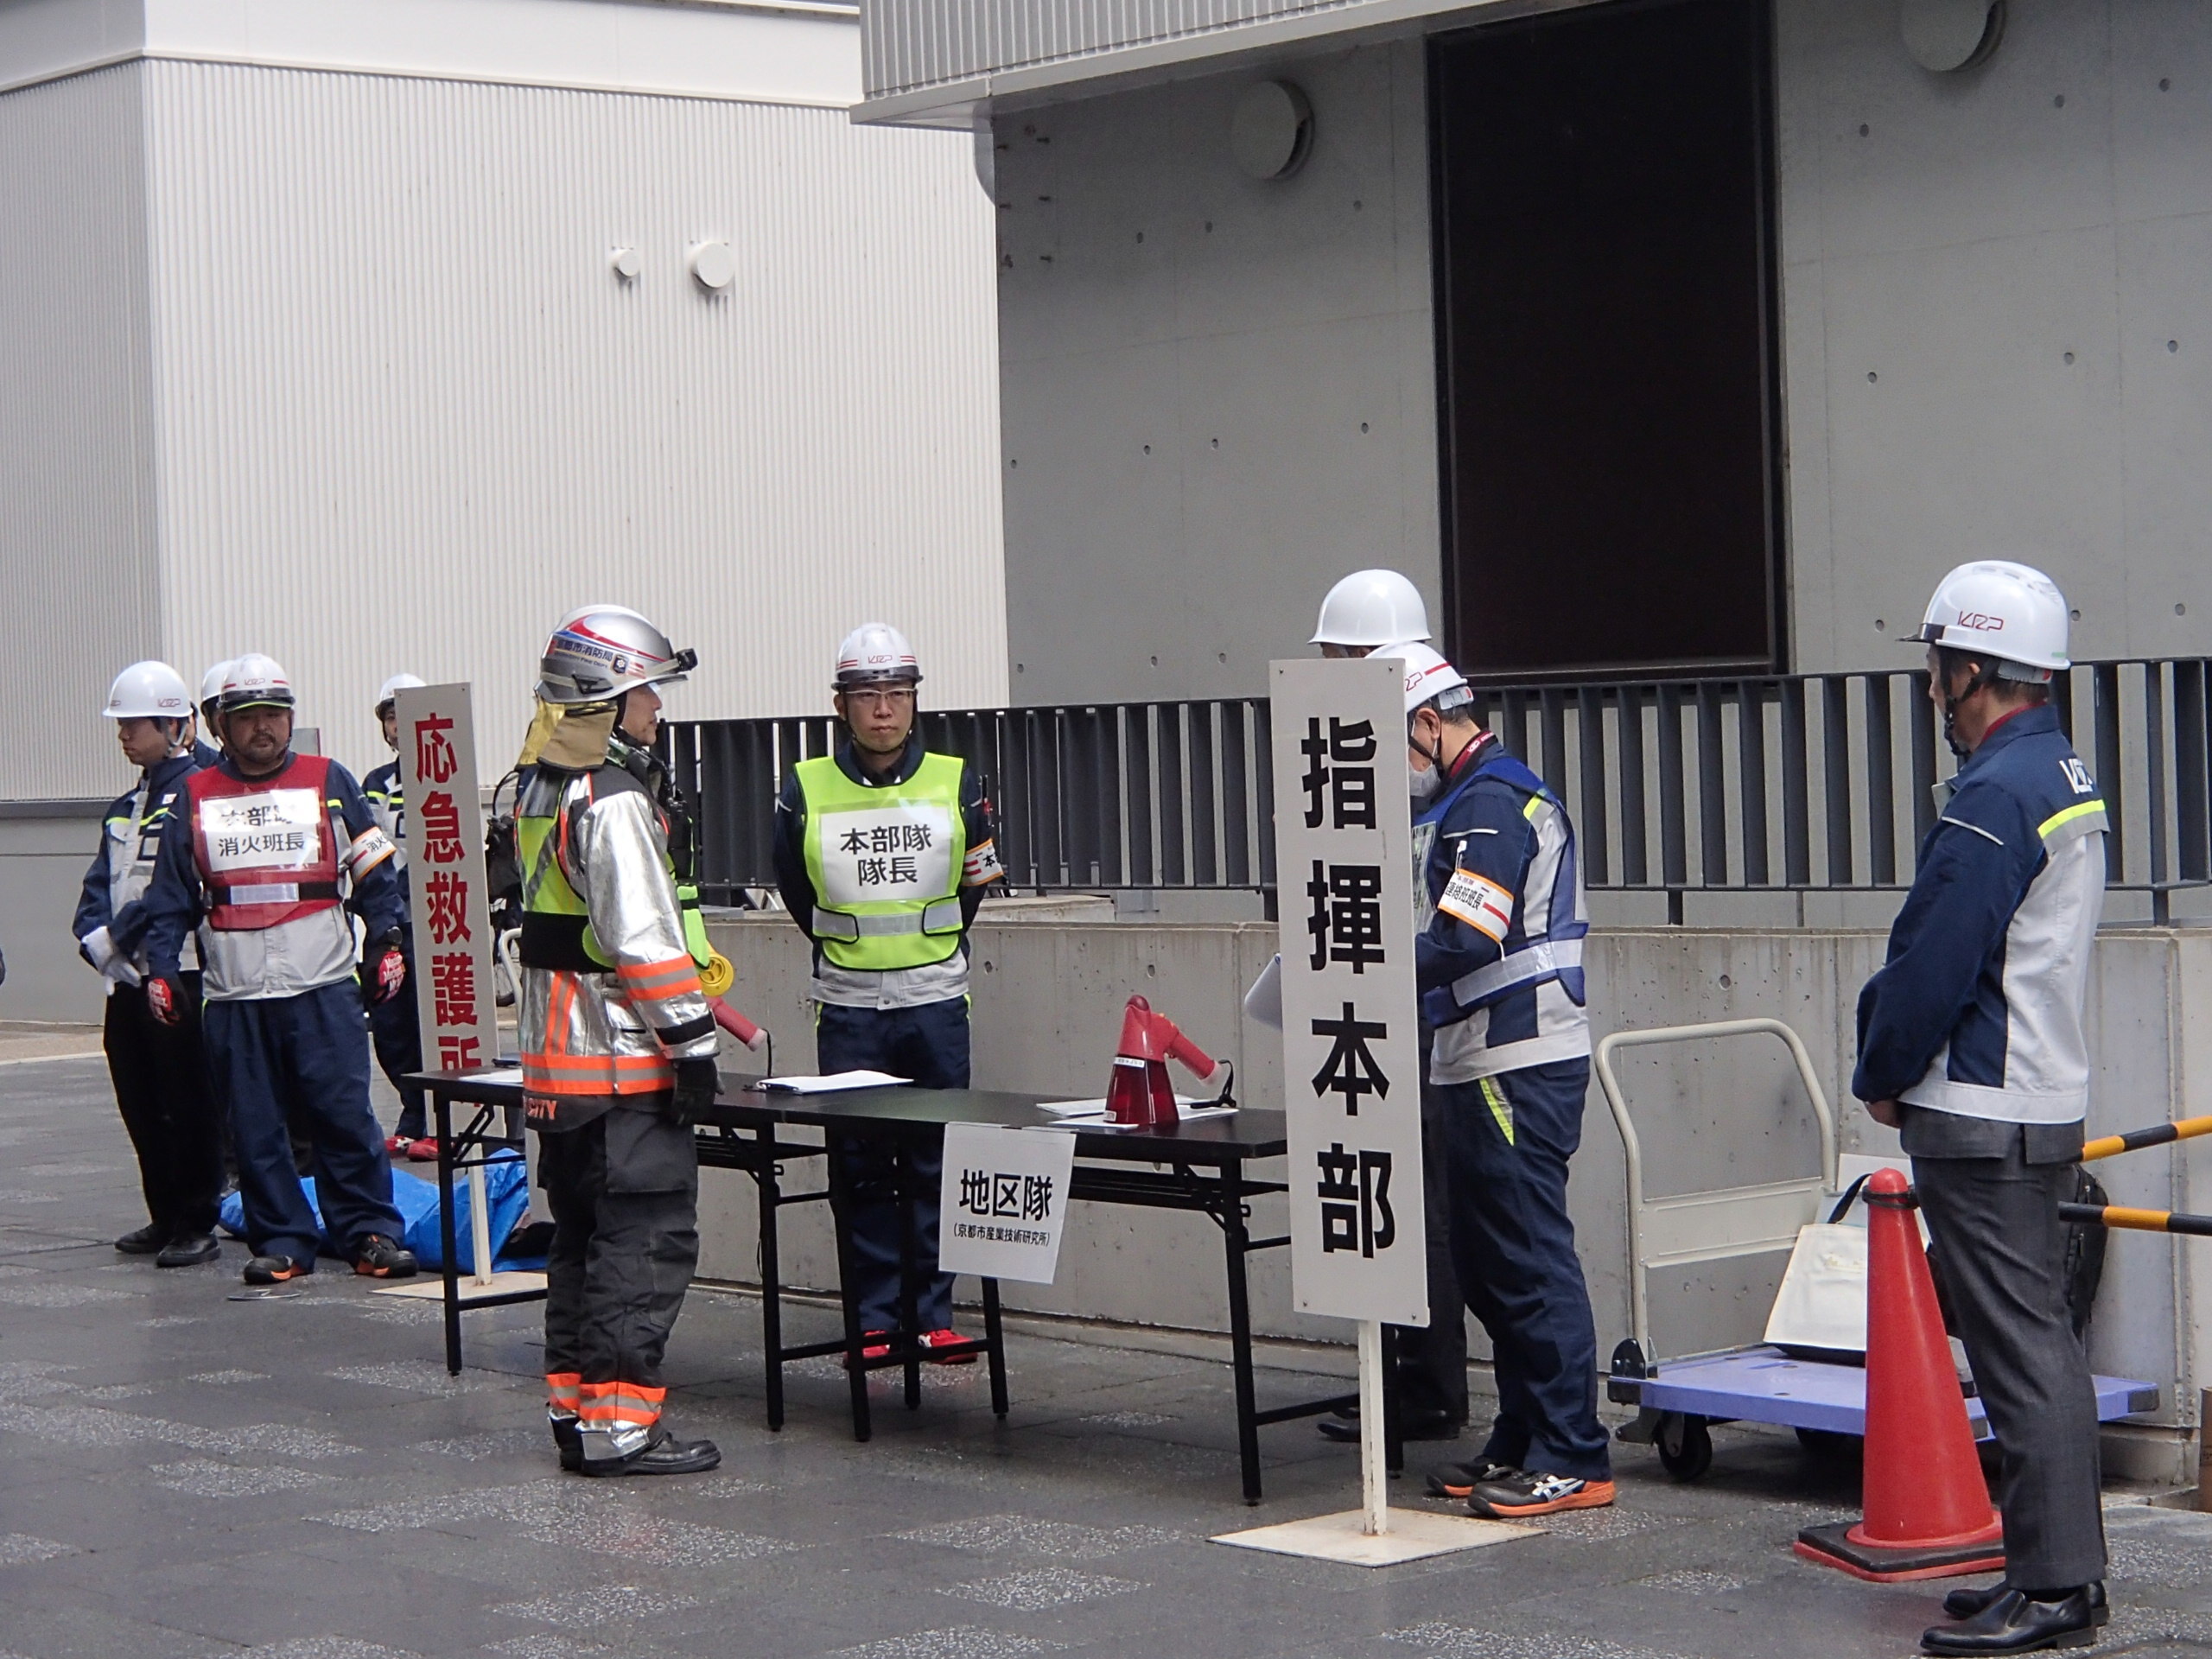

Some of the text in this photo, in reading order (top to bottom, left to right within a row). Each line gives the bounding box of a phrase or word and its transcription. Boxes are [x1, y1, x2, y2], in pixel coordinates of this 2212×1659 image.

[218, 831, 306, 857] 消火班長
[840, 823, 932, 855] 本部隊
[857, 856, 918, 887] 隊長
[1300, 716, 1395, 1259] 指揮本部
[958, 1168, 1053, 1222] 地区隊
